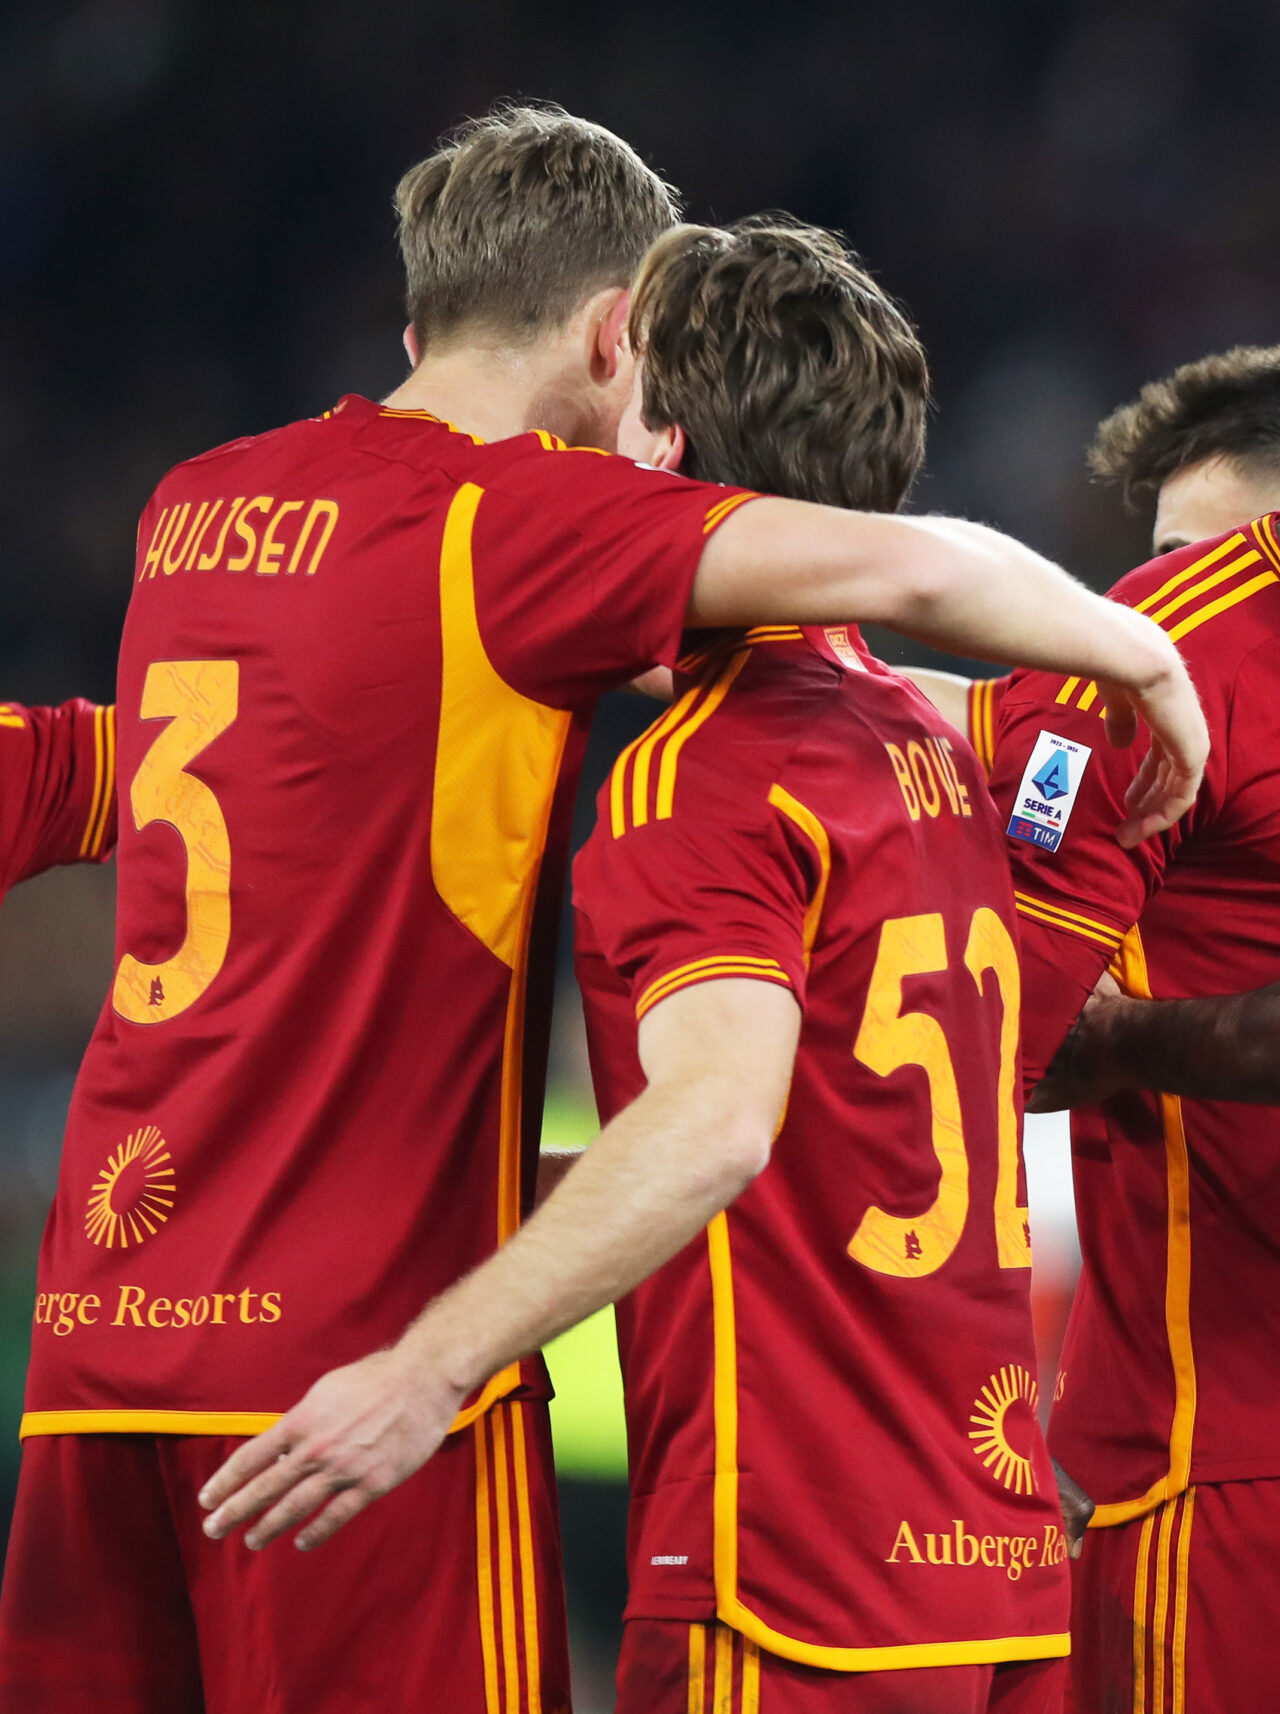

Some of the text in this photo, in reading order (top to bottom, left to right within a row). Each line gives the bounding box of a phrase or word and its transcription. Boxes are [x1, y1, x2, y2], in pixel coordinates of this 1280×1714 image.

[137, 496, 340, 583] HUIJSEN
[884, 736, 972, 822] BOVE
[1023, 798, 1062, 820] SERIE A
[112, 660, 239, 1025] 3
[1033, 827, 1056, 846] TIM
[847, 907, 1032, 1278] 52
[110, 1285, 282, 1329] Resorts
[884, 1519, 1038, 1581] Auberge
